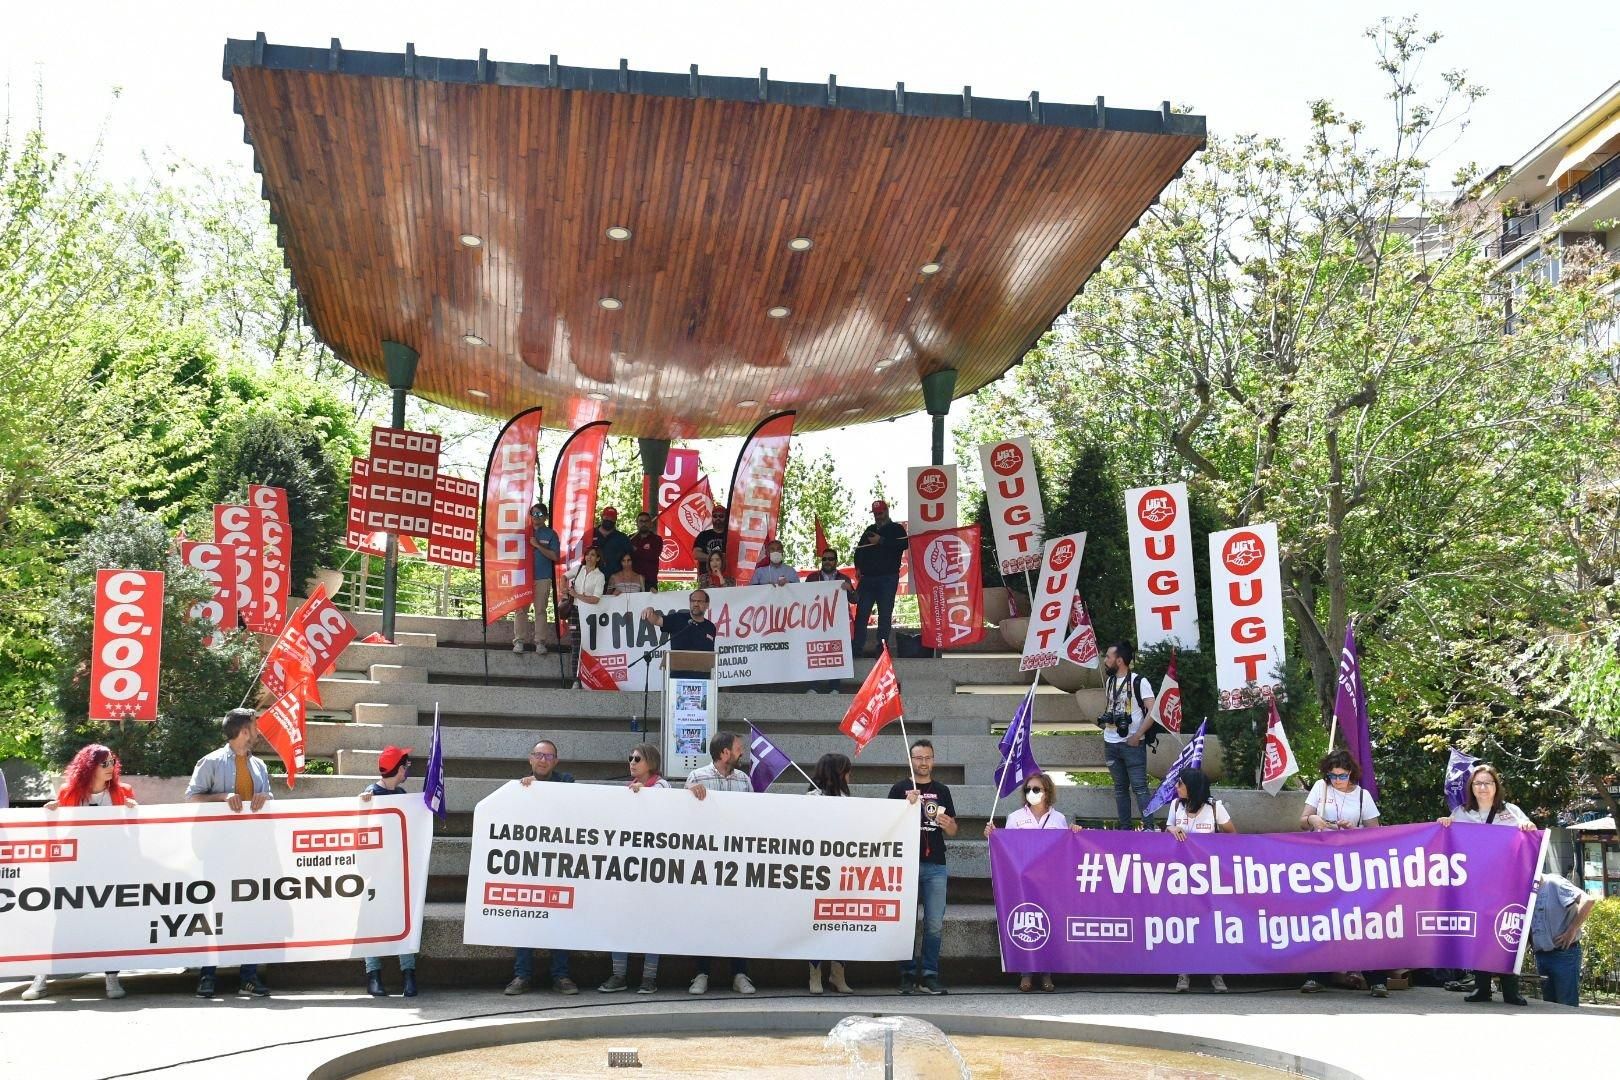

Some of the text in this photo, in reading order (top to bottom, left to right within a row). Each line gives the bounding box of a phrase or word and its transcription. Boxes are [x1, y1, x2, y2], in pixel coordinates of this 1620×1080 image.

[375, 431, 437, 453] CCOO
[372, 457, 434, 480] CCOO
[370, 485, 432, 506] CCOO
[435, 477, 477, 497] CCOO
[433, 500, 476, 519] CCOO
[497, 443, 529, 560] CCOO
[368, 511, 429, 533] CCOO
[998, 477, 1034, 553] UGT
[431, 522, 475, 541] CCOO
[429, 545, 473, 564] CCOO
[1144, 534, 1181, 631] UGT
[735, 589, 839, 638] SOLUCIÓN
[946, 581, 972, 643] FICA
[1036, 573, 1068, 650] UGT
[100, 572, 153, 701] CC.OO.
[1229, 578, 1268, 681] UGT
[718, 642, 789, 654] CONTENER PRECIOS
[808, 642, 830, 653] UGT
[599, 656, 624, 666] COO
[810, 656, 842, 667] CCOO
[296, 832, 354, 849] CCOO
[489, 823, 903, 858] LABORALES Y PERSONAL INTERINO DOCENTE
[0, 844, 46, 859] COO
[296, 854, 356, 867] ciudad real
[0, 867, 20, 879] itat
[487, 848, 903, 892] CONTRATACION A 12 MESES ¡¡YA!!
[1076, 847, 1468, 895] #VivasLibresUnidas
[231, 874, 376, 902] DIGNO,
[488, 887, 546, 903] CCOO
[482, 906, 549, 919] enseñanza
[818, 903, 873, 917] CCOO
[1014, 911, 1044, 928] UGT
[150, 912, 224, 943] ¡YA!
[812, 920, 877, 932] enseñanza
[1072, 922, 1129, 937] CCOO
[1144, 904, 1404, 950] por la igualdad
[1421, 916, 1470, 931] CCOO
